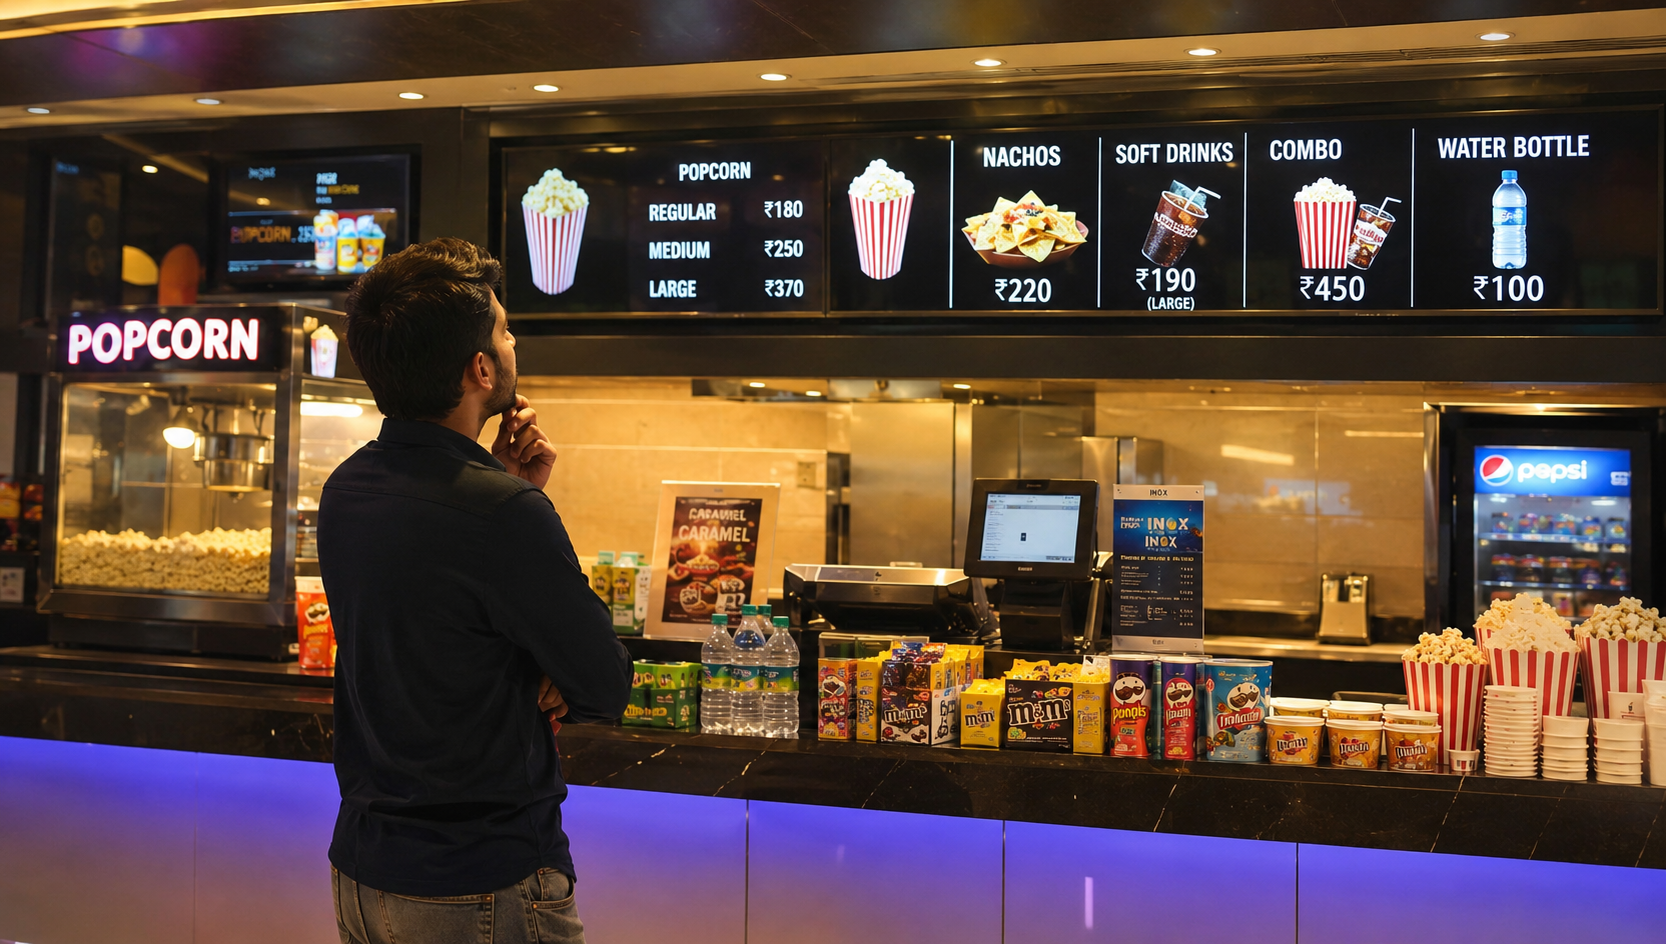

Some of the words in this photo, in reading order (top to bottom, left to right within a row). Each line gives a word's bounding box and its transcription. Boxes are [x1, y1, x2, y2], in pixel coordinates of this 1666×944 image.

[983, 145, 1061, 168] NACHOS
[1115, 143, 1161, 165] SOFT
[1166, 142, 1234, 164] DRINKS
[1269, 138, 1342, 161] COMBO
[1438, 136, 1506, 158] WATER
[1514, 135, 1590, 158] BOTTLE
[678, 161, 751, 182] POPCORN
[649, 202, 717, 222] REGULAR
[764, 200, 803, 219] ₹180
[649, 241, 711, 260] MEDIUM
[764, 239, 804, 258] ₹250
[649, 279, 697, 299] LARGE
[764, 278, 804, 298] ₹370
[994, 278, 1052, 303] ₹220
[1136, 267, 1196, 292] ₹190
[1299, 275, 1366, 302] ₹450
[1473, 275, 1544, 302] ₹100
[1146, 296, 1195, 311] (LARGE)
[68, 317, 260, 365] POPCORN
[1517, 459, 1588, 484] pepsi
[678, 525, 751, 543] CARAMEL
